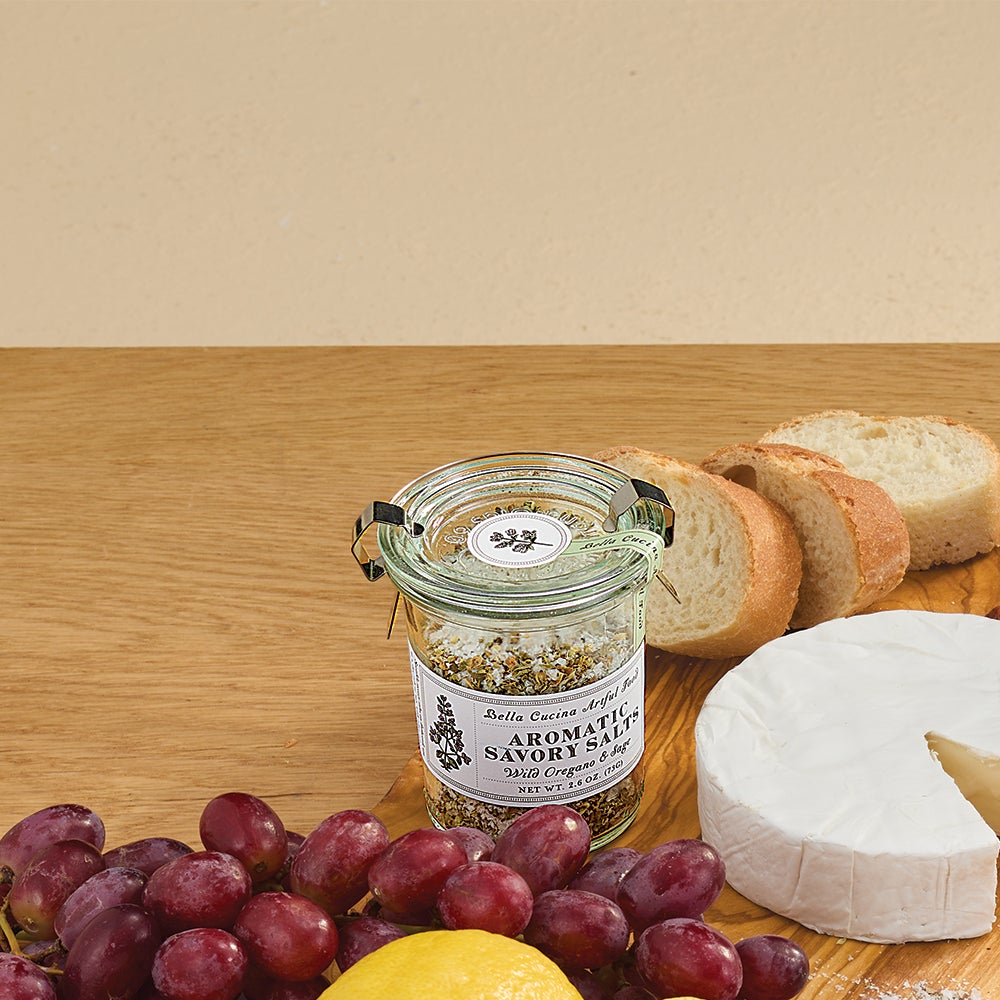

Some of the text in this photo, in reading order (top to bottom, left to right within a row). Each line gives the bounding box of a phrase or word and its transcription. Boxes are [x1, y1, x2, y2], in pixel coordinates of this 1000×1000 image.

[483, 667, 639, 722] Bella Cucina Artful Food
[484, 706, 639, 763] SAVORY SALTS
[508, 701, 629, 747] AROMATIC
[503, 737, 632, 780] Wild Oregano & Sage
[517, 785, 542, 794] NET
[544, 784, 565, 793] WT.
[568, 778, 582, 789] 2.6
[584, 773, 602, 784] OZ.
